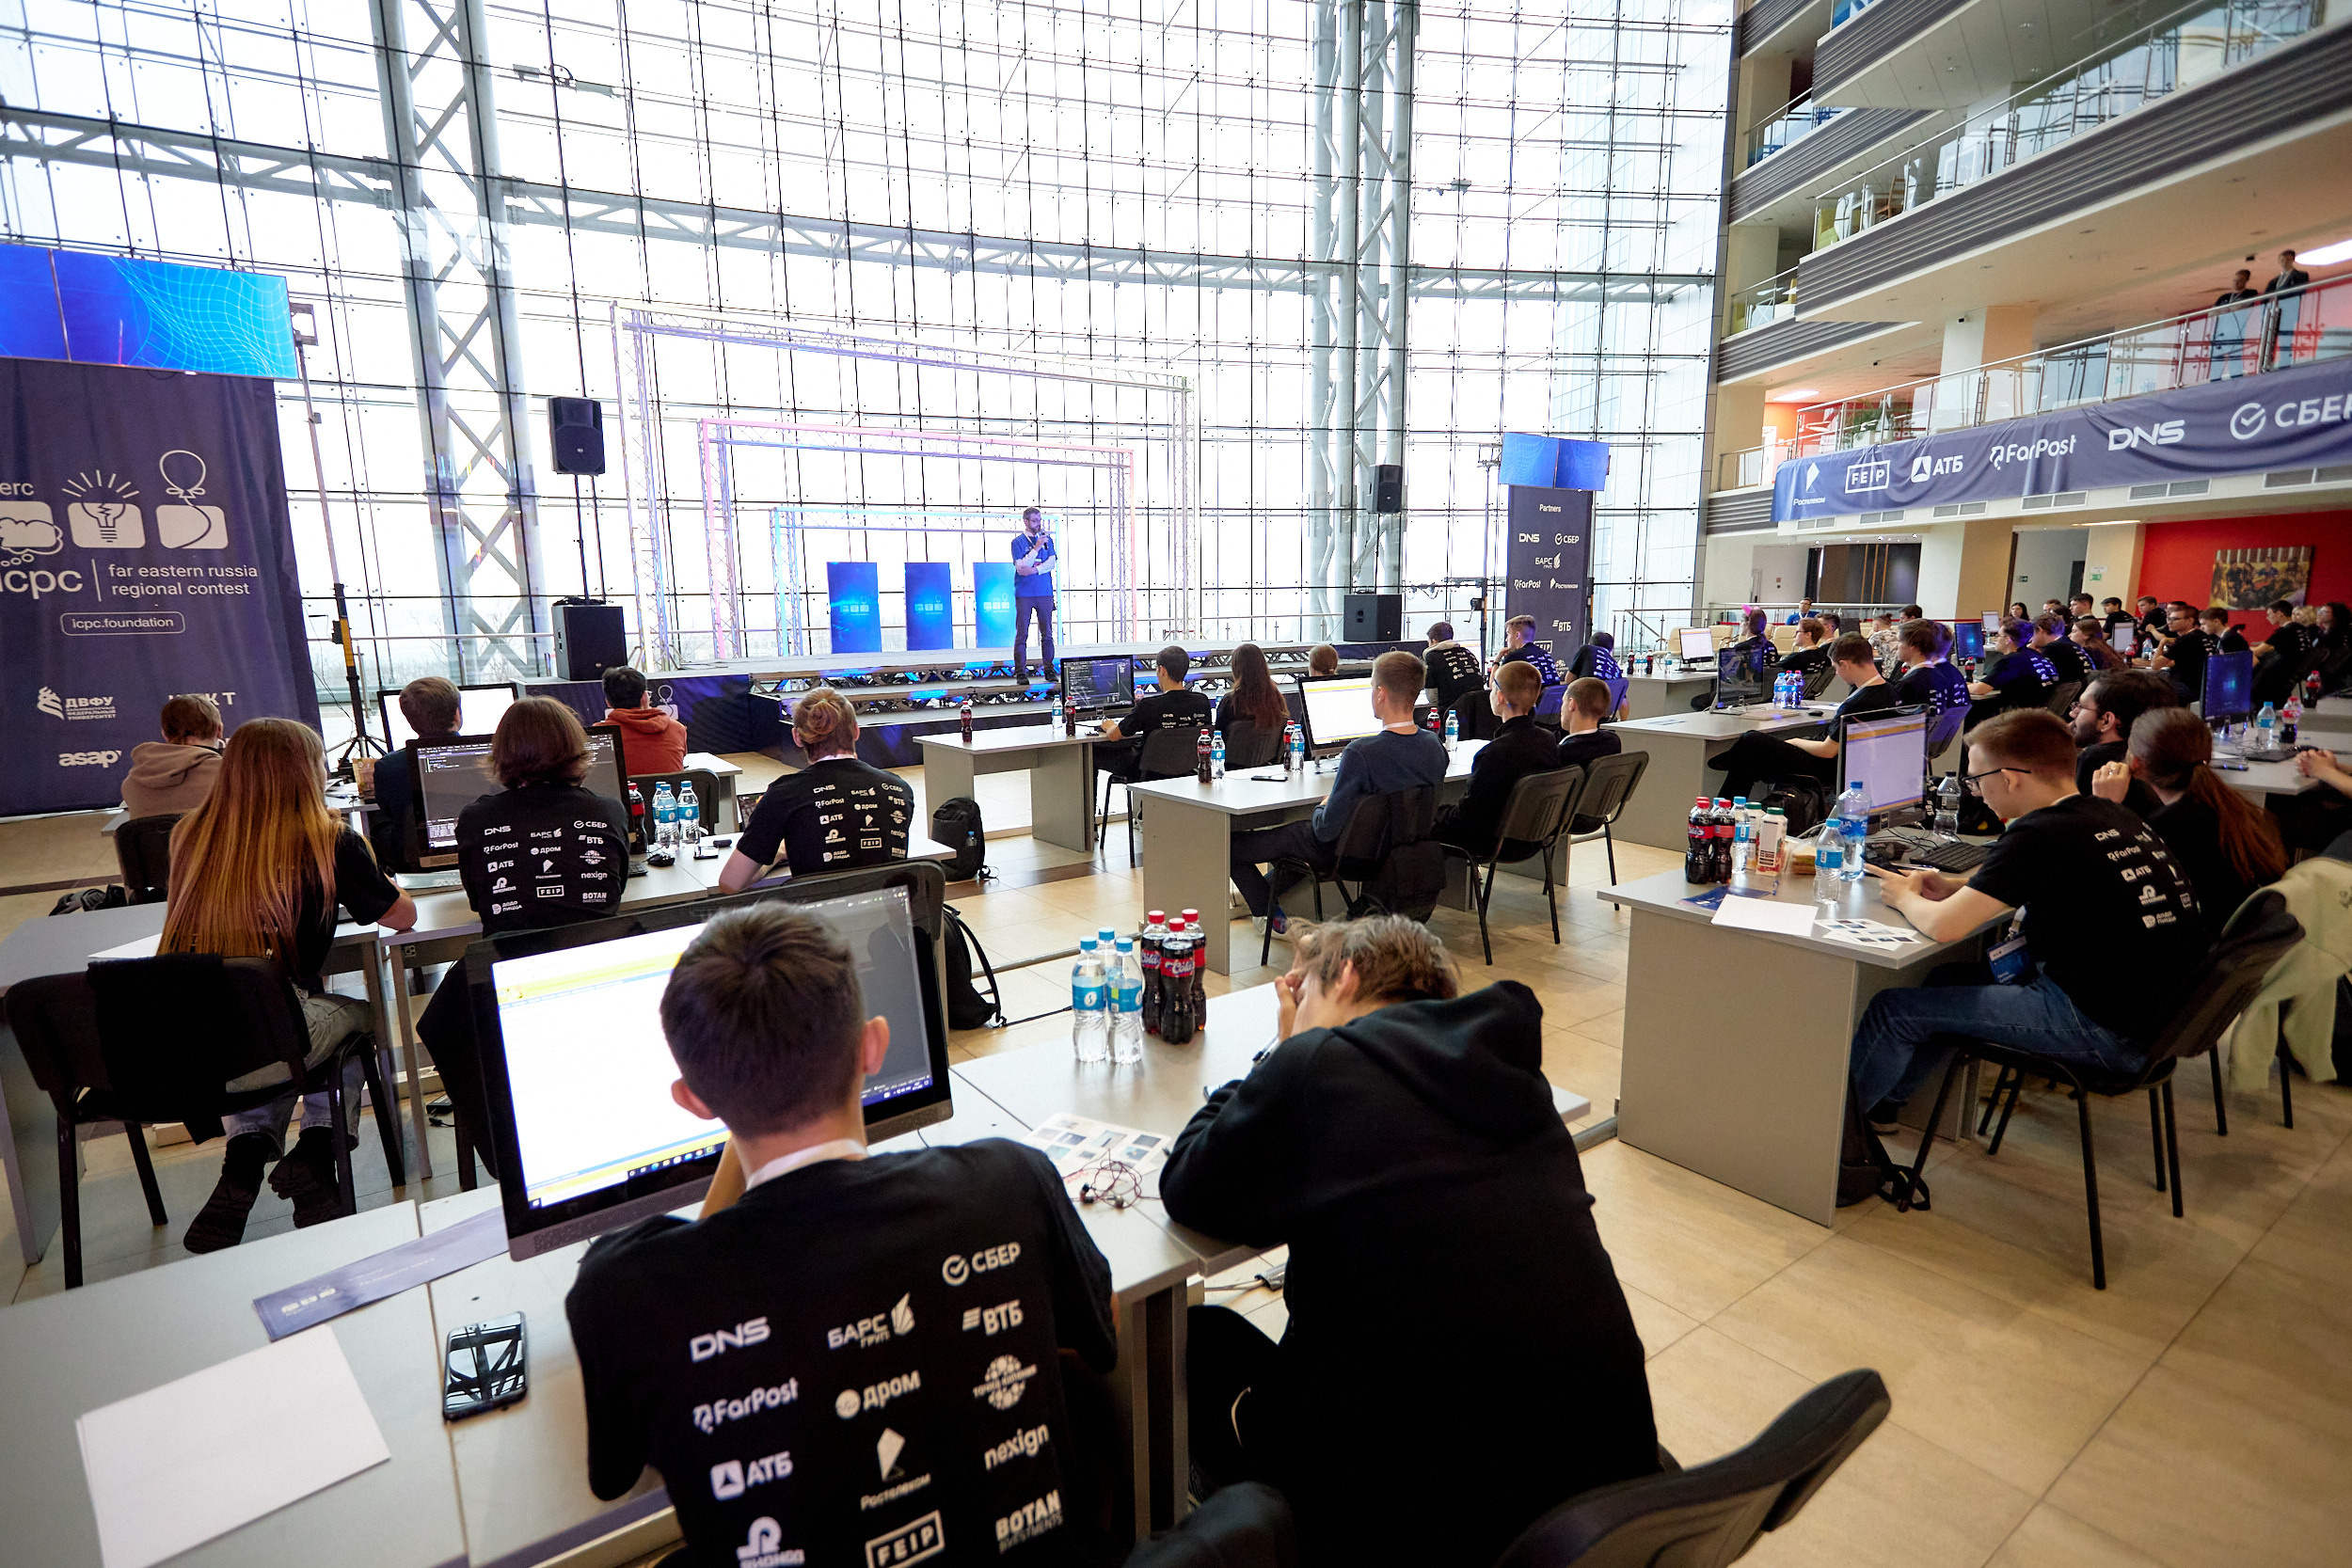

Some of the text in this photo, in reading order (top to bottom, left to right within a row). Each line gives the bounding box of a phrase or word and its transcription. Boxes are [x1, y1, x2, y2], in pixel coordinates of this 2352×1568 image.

[2108, 420, 2185, 451] DNS
[2006, 435, 2076, 463] FarPost
[1932, 455, 1963, 476] АТБ
[1851, 472, 1885, 485] FEIP
[1539, 504, 1561, 513] Partners
[1518, 532, 1540, 543] DNS
[1564, 535, 1580, 544] СБЕР
[108, 564, 258, 578] far eastern russia
[112, 582, 250, 599] regional contest
[72, 617, 174, 630] icpc.foundation
[1558, 622, 1572, 631] ВТБ
[66, 696, 114, 708] ДВФУ
[813, 784, 835, 794] DNS
[485, 826, 511, 835] DNS
[2094, 829, 2120, 842] DNS
[499, 860, 514, 869] АТБ
[2136, 865, 2153, 878] АТБ
[581, 870, 608, 880] nexign
[972, 1242, 1021, 1274] СБЕР
[983, 1299, 1024, 1336] ВТБ
[828, 1313, 888, 1350] БАРС
[690, 1316, 771, 1362] DNS
[984, 1423, 1050, 1470] nexign
[746, 1450, 794, 1487] АТБ
[860, 1472, 931, 1511] Ростелеком
[995, 1489, 1062, 1543] BOTAN
[877, 1525, 935, 1566] FEIP
